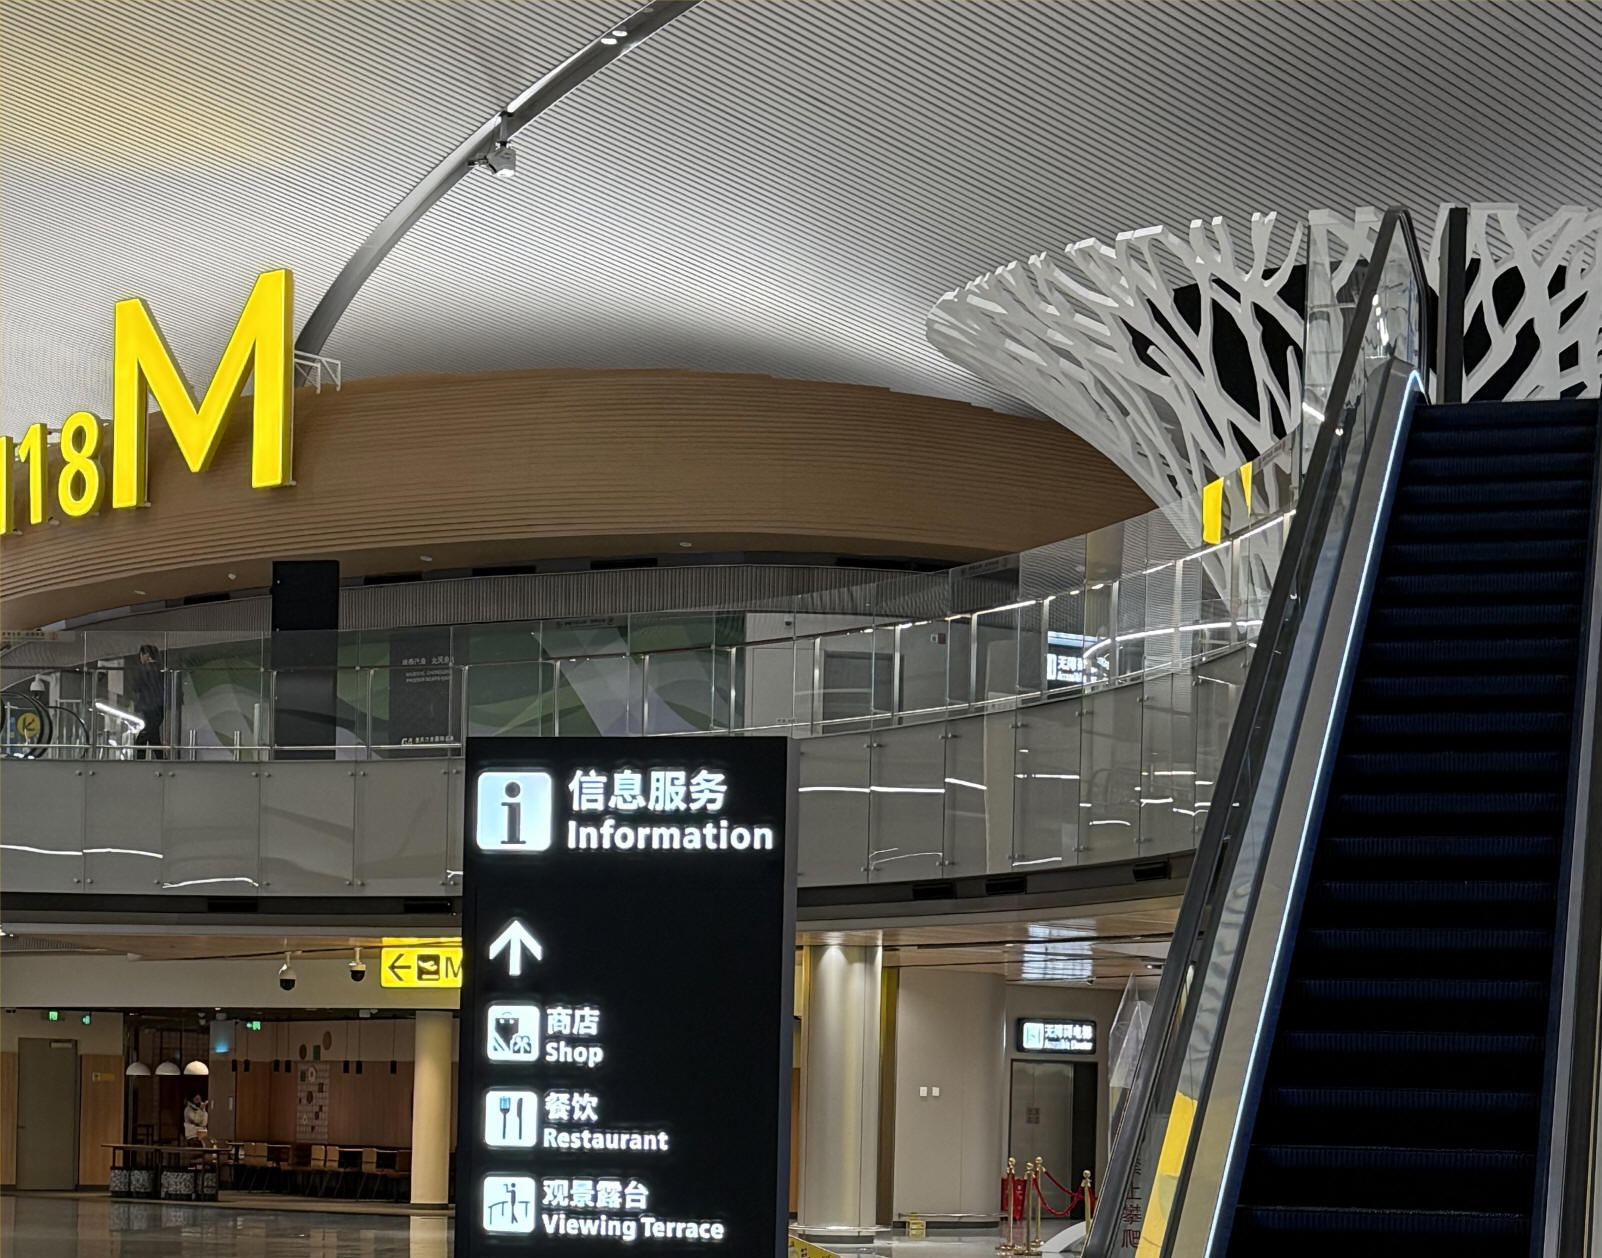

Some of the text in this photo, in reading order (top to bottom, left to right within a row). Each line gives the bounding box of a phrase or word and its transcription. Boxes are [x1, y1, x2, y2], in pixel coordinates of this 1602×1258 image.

[112, 268, 294, 509] M
[568, 769, 727, 813] 信息服务
[568, 819, 773, 849] Information
[547, 1006, 600, 1037] 商店
[546, 1040, 603, 1067] Shop
[545, 1092, 598, 1122] 餐饮
[543, 1128, 668, 1151] Restaurant
[542, 1177, 649, 1211] 观景露台
[542, 1212, 724, 1241] Viewing Terrace
